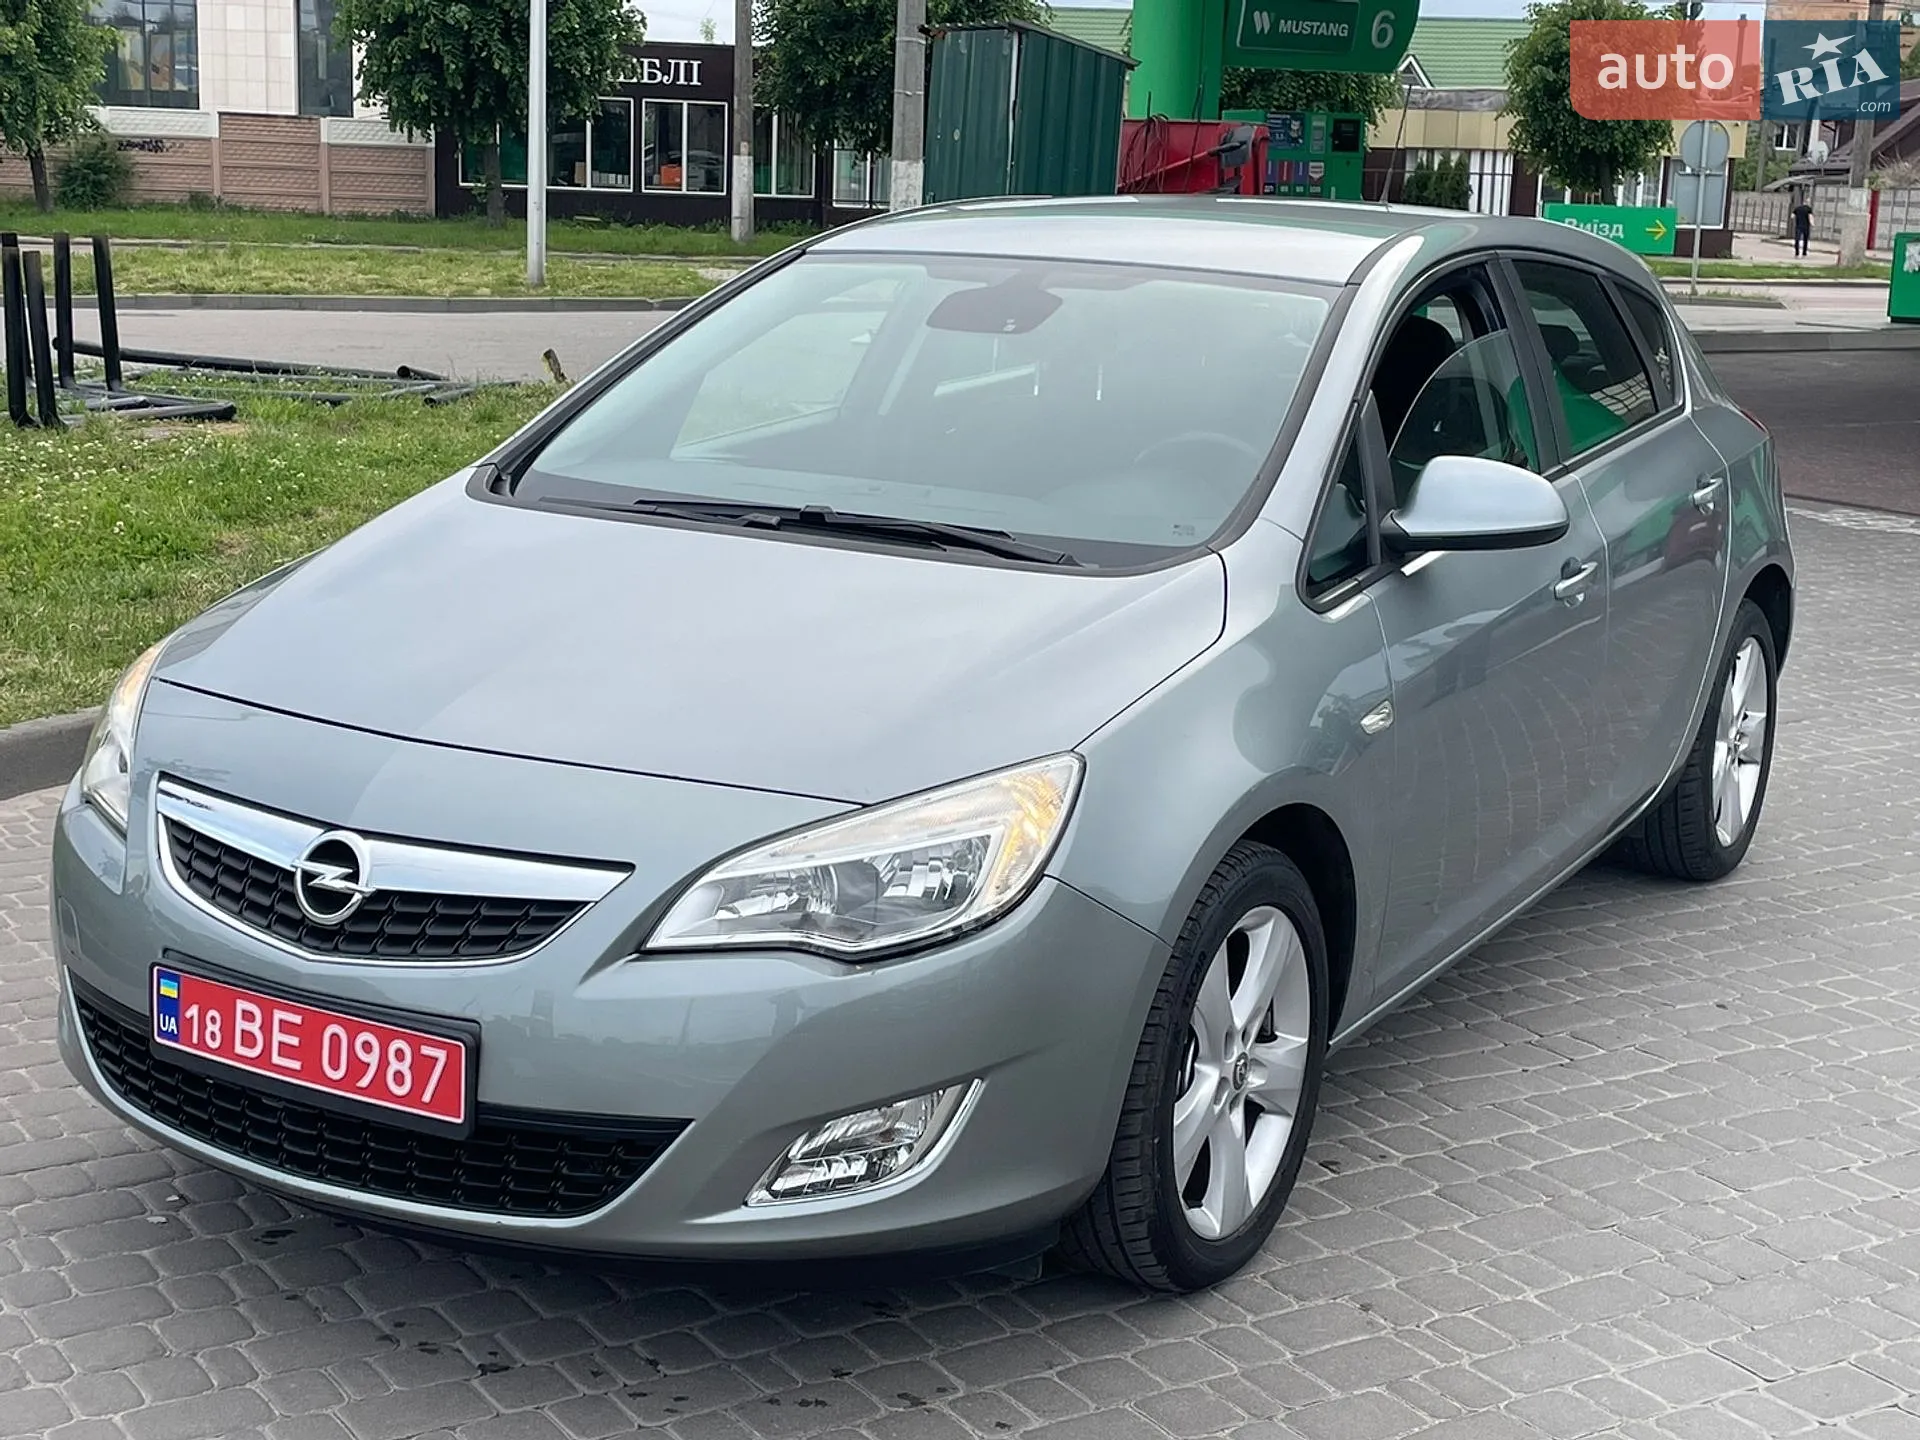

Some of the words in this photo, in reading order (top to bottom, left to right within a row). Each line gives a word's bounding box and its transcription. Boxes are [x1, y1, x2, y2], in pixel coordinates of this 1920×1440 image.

[1279, 19, 1349, 37] MUSTANG
[1371, 10, 1395, 49] 6
[160, 1012, 177, 1035] UA
[184, 1003, 222, 1050] 18
[233, 998, 302, 1070] BE
[321, 1023, 447, 1104] 0987
